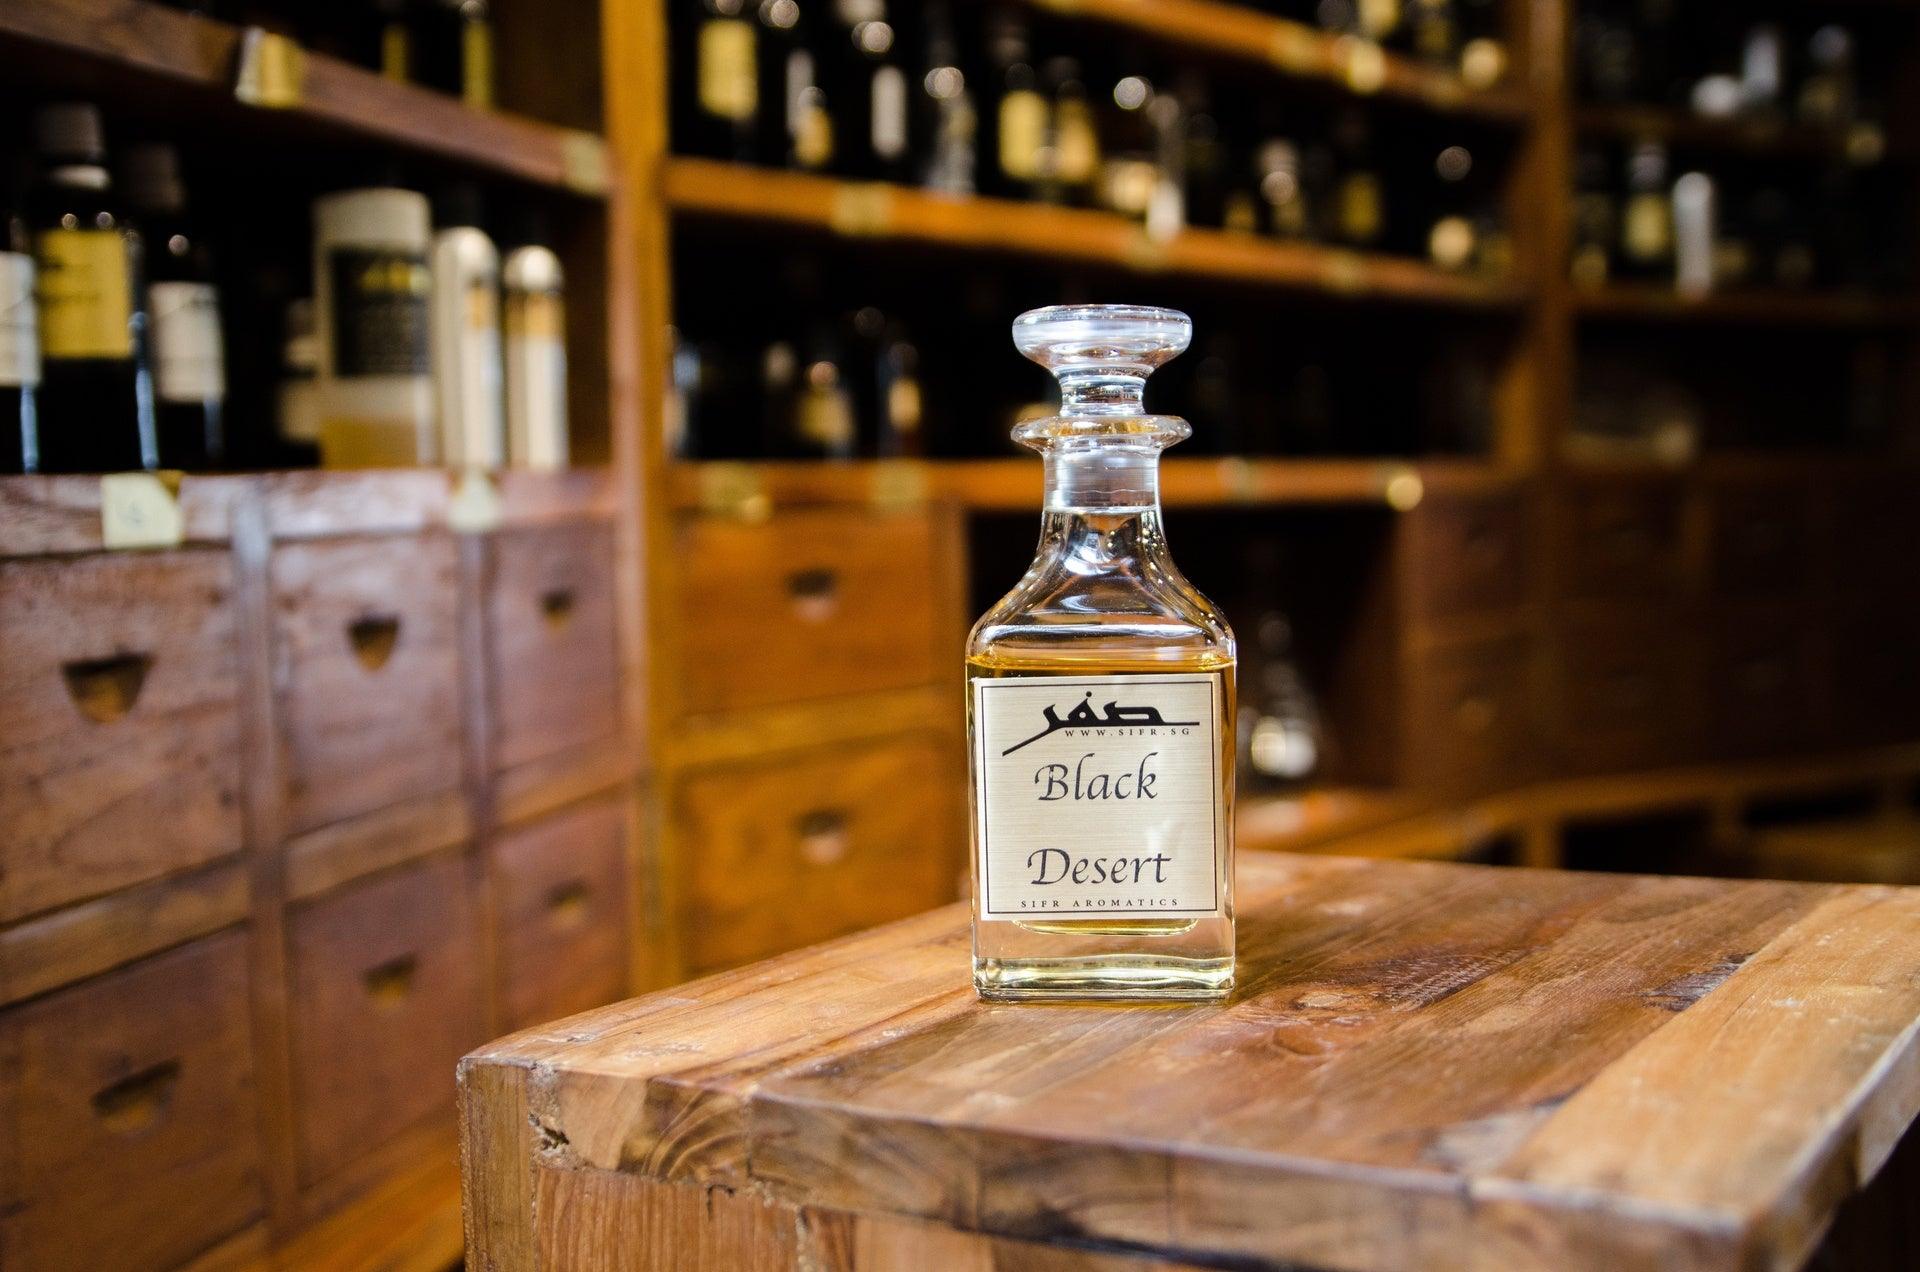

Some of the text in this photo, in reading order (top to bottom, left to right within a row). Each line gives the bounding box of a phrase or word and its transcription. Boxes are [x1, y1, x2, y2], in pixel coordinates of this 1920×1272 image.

[1002, 691, 1200, 757] صفر
[1064, 727, 1191, 738] WWW.SIFR.SG
[1034, 752, 1159, 801] Black
[1027, 847, 1172, 886] Desert
[1021, 898, 1179, 908] SIFR AROMATICS
